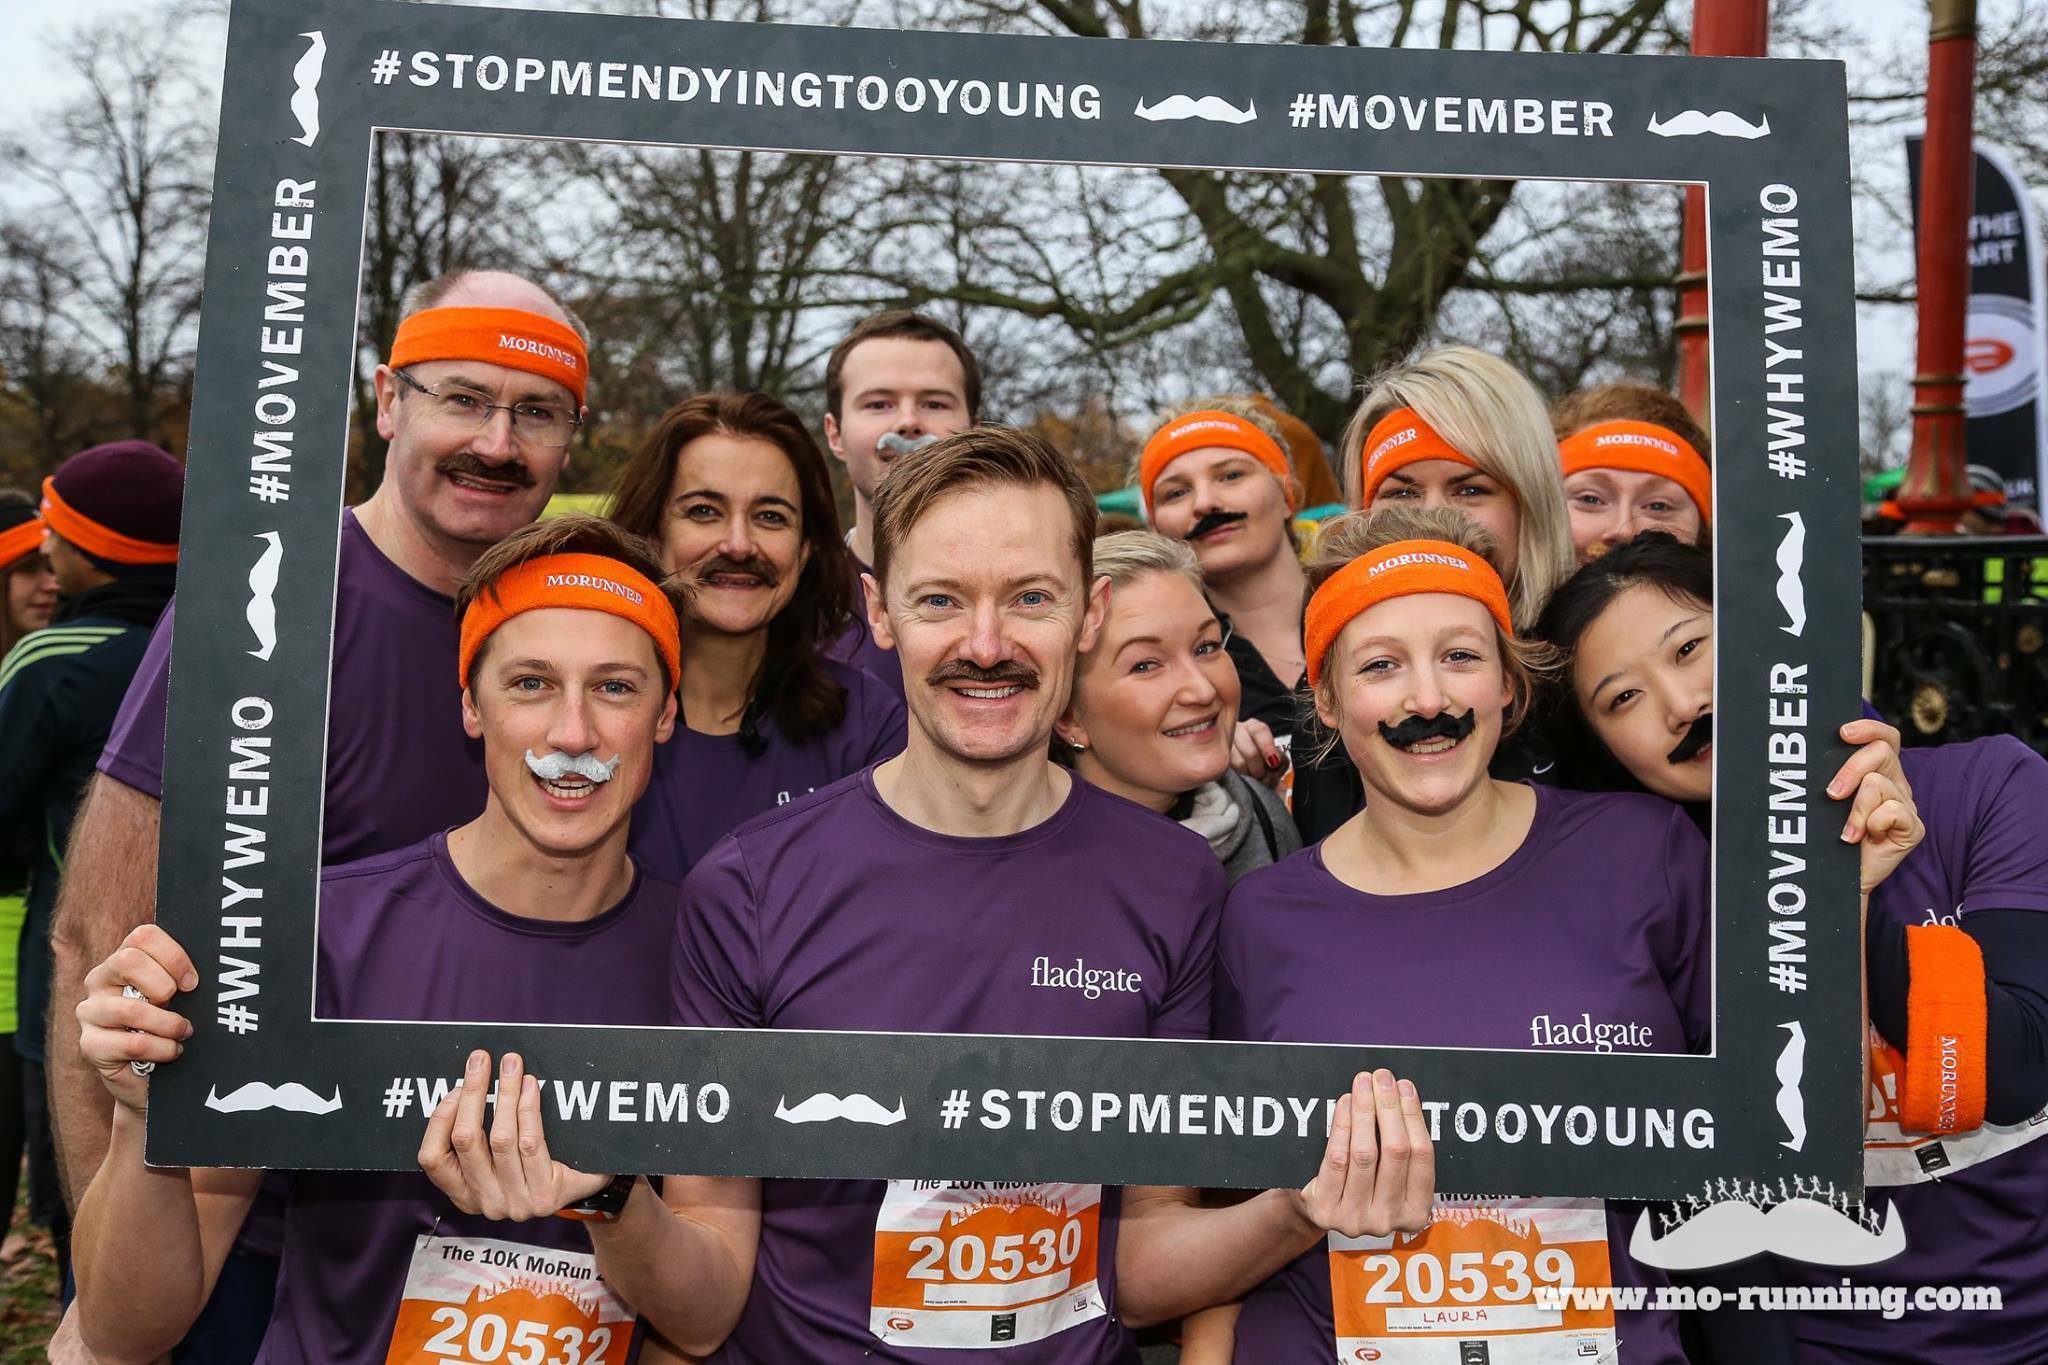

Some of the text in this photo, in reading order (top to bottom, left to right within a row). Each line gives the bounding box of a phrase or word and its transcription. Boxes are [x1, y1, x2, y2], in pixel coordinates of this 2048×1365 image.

[371, 48, 1615, 137] #STOPMENDYINGTOOYOUNG #MOVEMBER
[546, 574, 644, 605] MORUNNER
[1368, 552, 1470, 578] MORUNNER
[1759, 183, 1809, 994] #MOVEMBER #WHYWEMO
[217, 177, 317, 1035] #WHYWEMO #MOVEMBER
[1031, 955, 1143, 1001] fladgate
[1529, 1013, 1654, 1053] fladgate
[382, 1077, 1716, 1151] #WWEMO #STOPMENDYITOOYOUNG
[442, 1245, 475, 1262] The
[480, 1247, 521, 1270] 10K
[525, 1255, 592, 1281] MoRun
[906, 1218, 1082, 1280] 20530
[1363, 1248, 1576, 1304] 20539
[429, 1306, 612, 1365] 20532
[1423, 1309, 1489, 1324] LAURA
